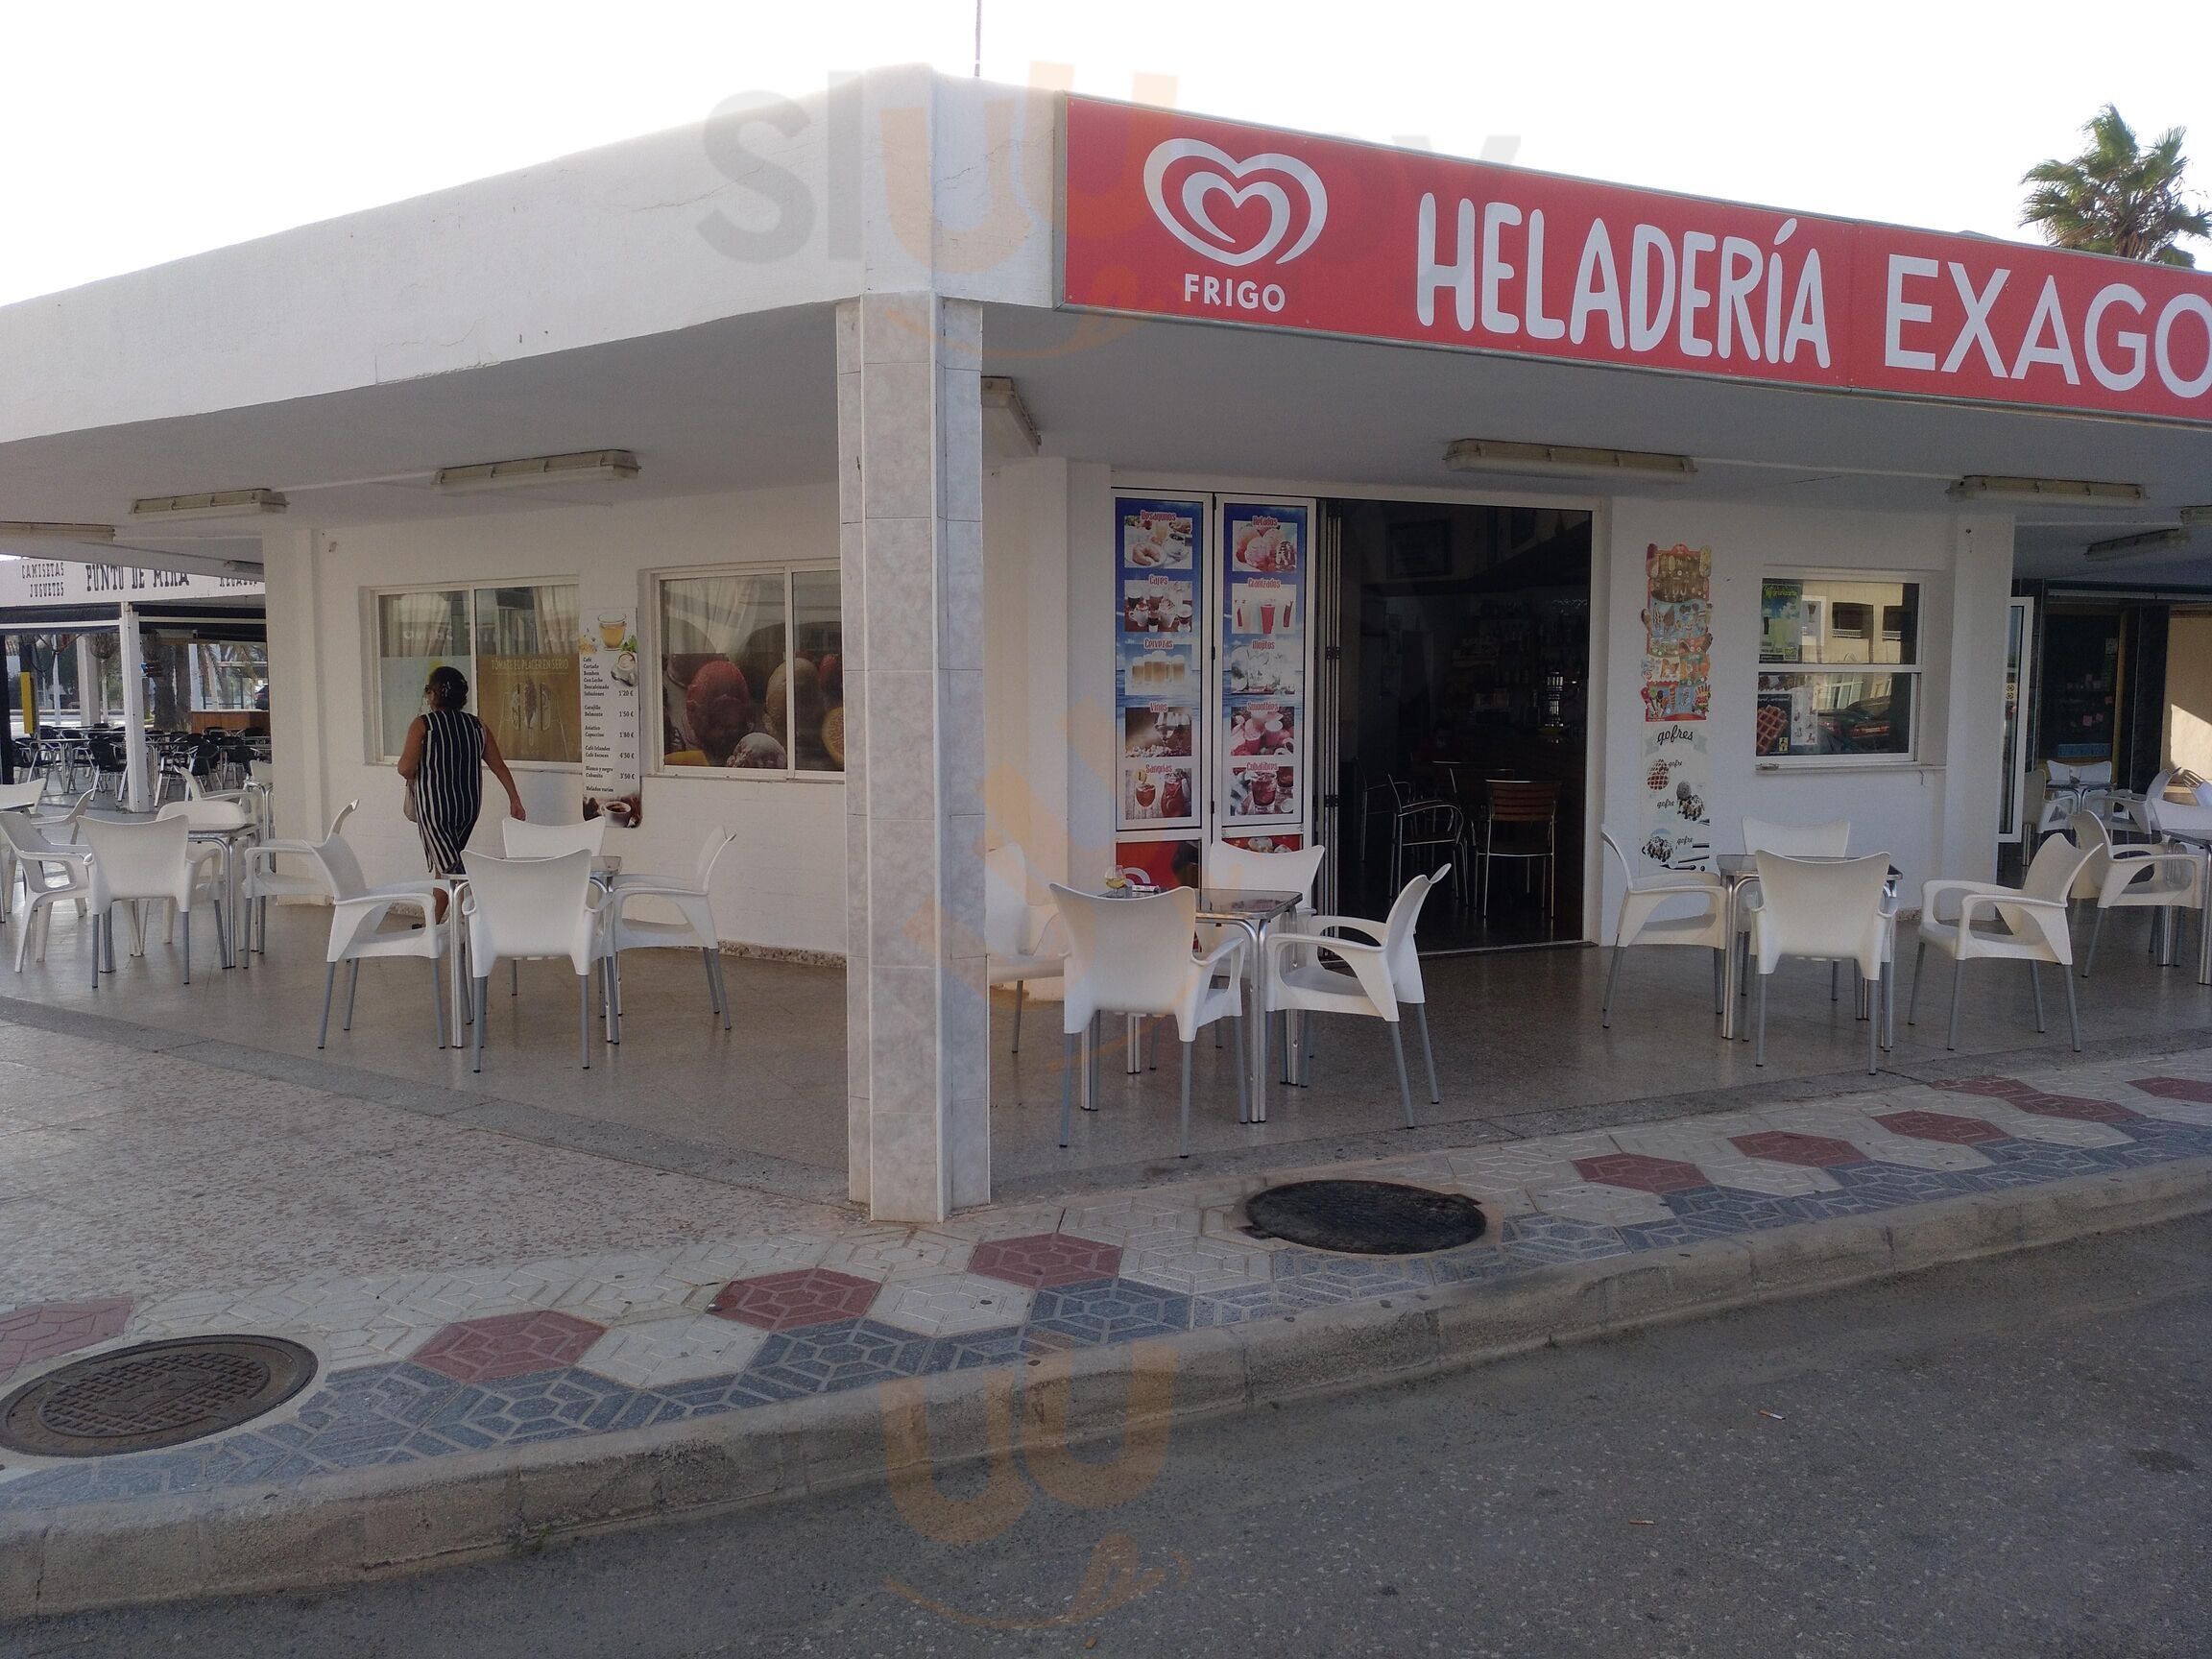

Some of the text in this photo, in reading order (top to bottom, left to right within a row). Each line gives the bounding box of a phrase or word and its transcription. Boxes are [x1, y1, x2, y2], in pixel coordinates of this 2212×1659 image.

[1183, 273, 1287, 313] FRIGO
[1416, 191, 2212, 399] HELADERÍA EXAGO
[22, 562, 63, 578] CAMISETAS
[30, 582, 63, 597] JUGUETES
[1144, 638, 1173, 648] Cervezas
[1252, 640, 1275, 649] Mojitos
[1150, 703, 1167, 711] Vinos
[1657, 724, 1694, 745] gofres
[1657, 799, 1675, 808] gofre
